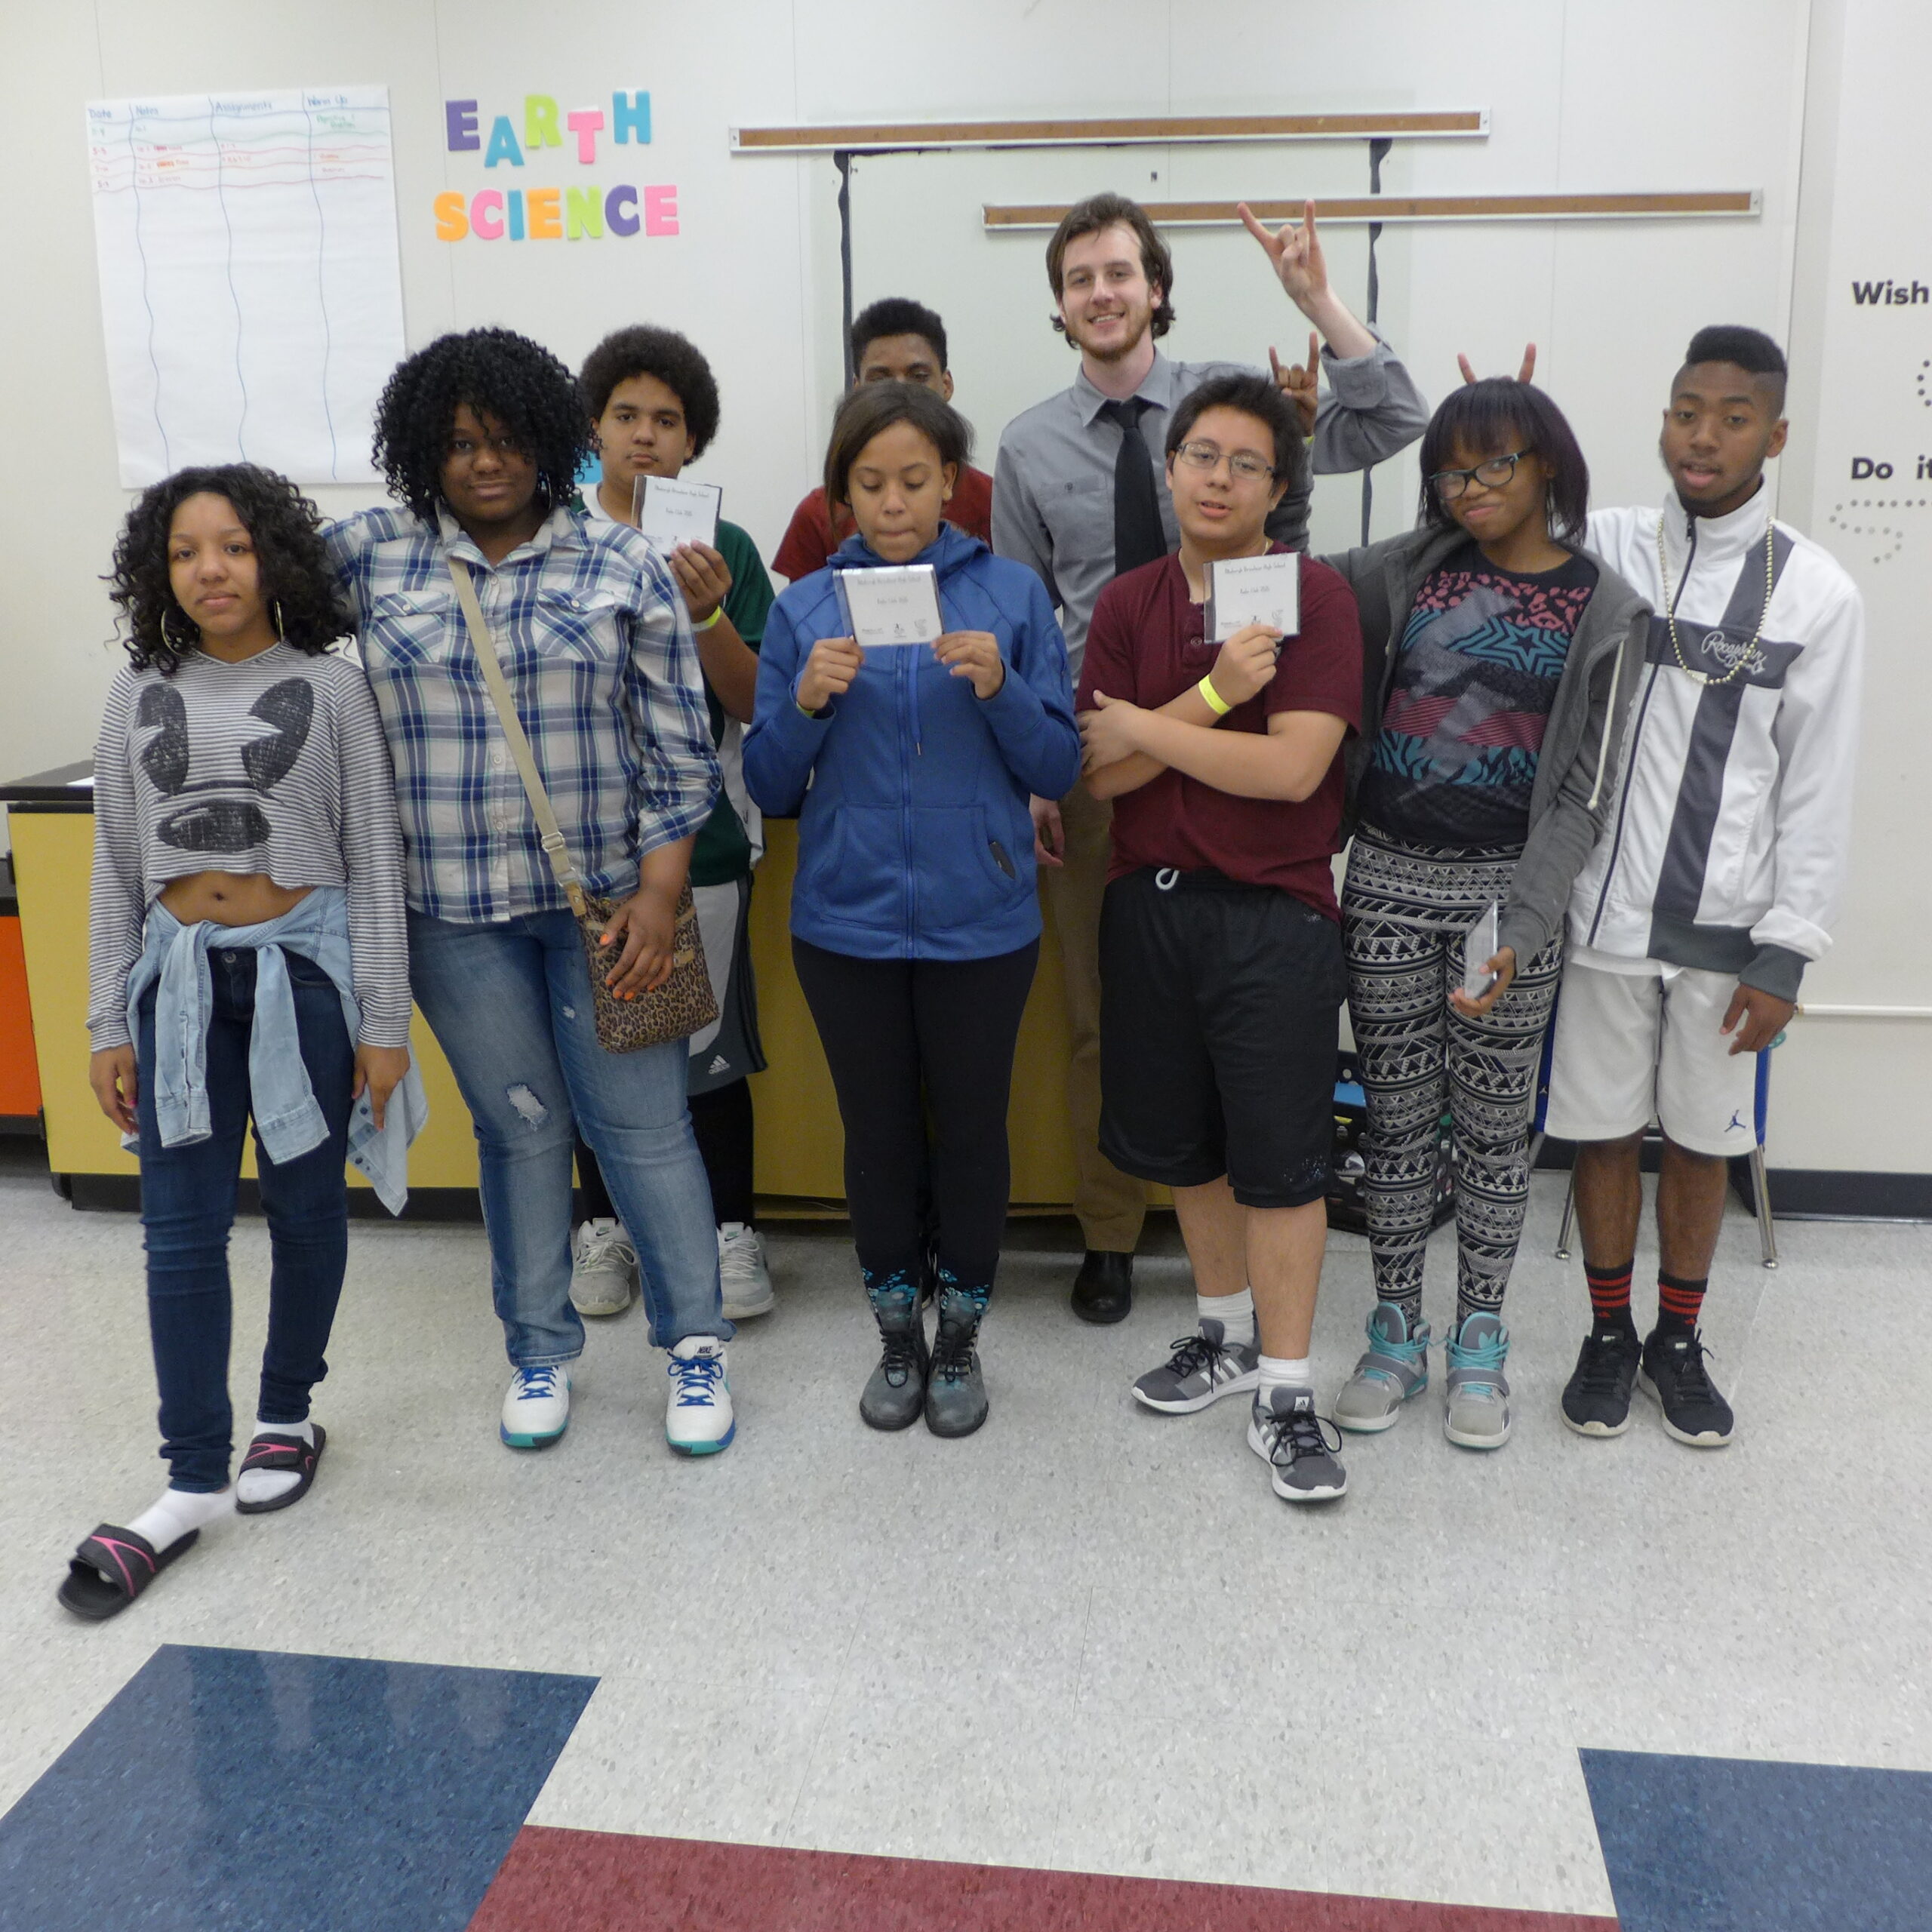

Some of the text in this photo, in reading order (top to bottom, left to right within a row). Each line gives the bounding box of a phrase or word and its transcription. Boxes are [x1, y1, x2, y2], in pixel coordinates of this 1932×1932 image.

[445, 91, 651, 168] EARTH
[433, 184, 679, 242] SCIENCE
[1852, 280, 1928, 305] Wish
[1851, 457, 1894, 479] Do
